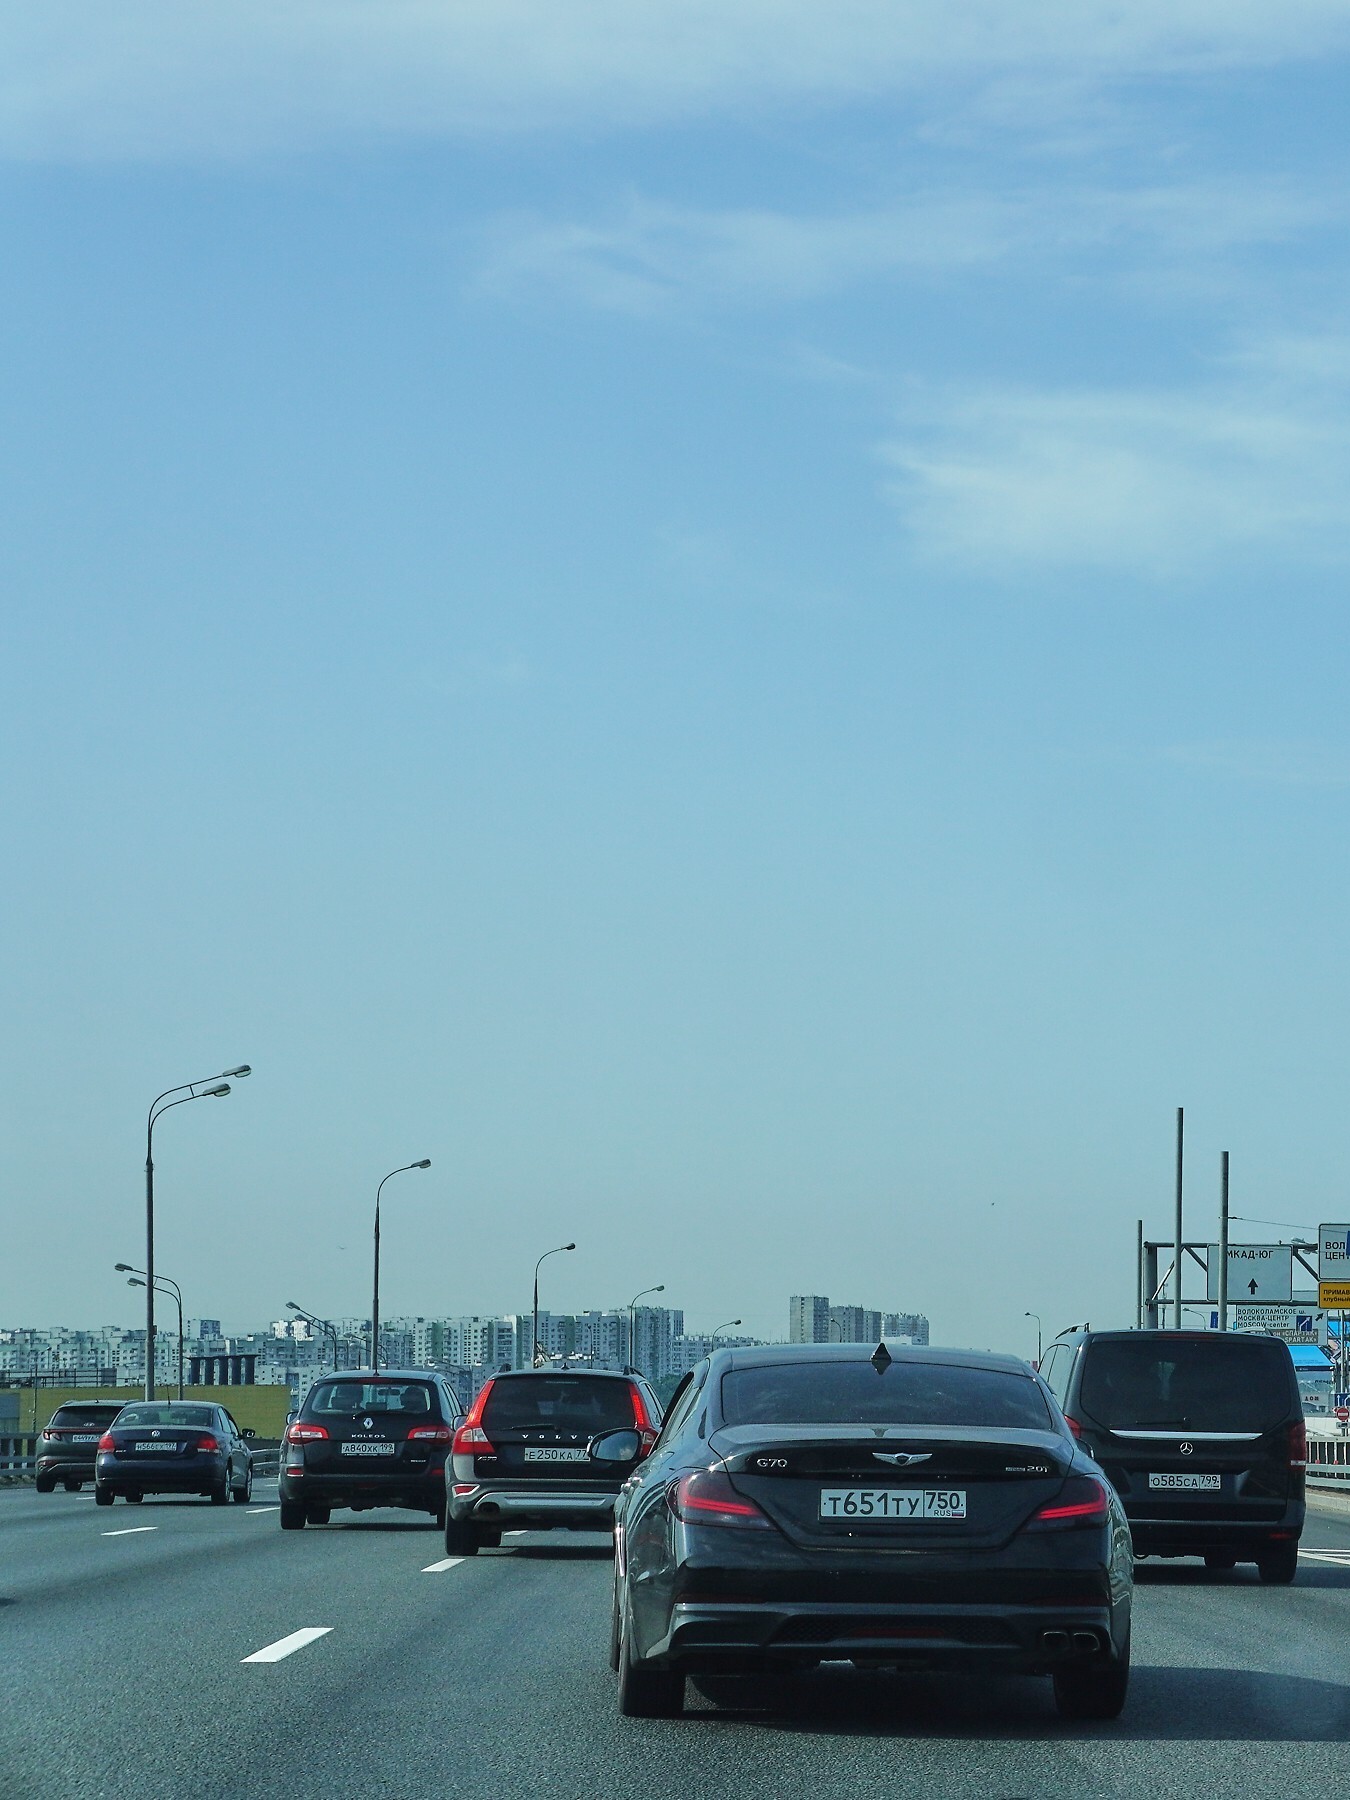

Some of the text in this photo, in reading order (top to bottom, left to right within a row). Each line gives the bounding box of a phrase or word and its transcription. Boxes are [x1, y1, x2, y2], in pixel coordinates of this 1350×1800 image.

[1237, 1308, 1297, 1316] ВОЛОКОЛАМСКОЕ
[528, 1449, 573, 1461] Е250КА
[756, 1458, 789, 1468] G70
[1152, 1475, 1218, 1487] О585СА 799
[828, 1491, 960, 1516] Т651ТУ 750
[933, 1509, 952, 1517] RUS
